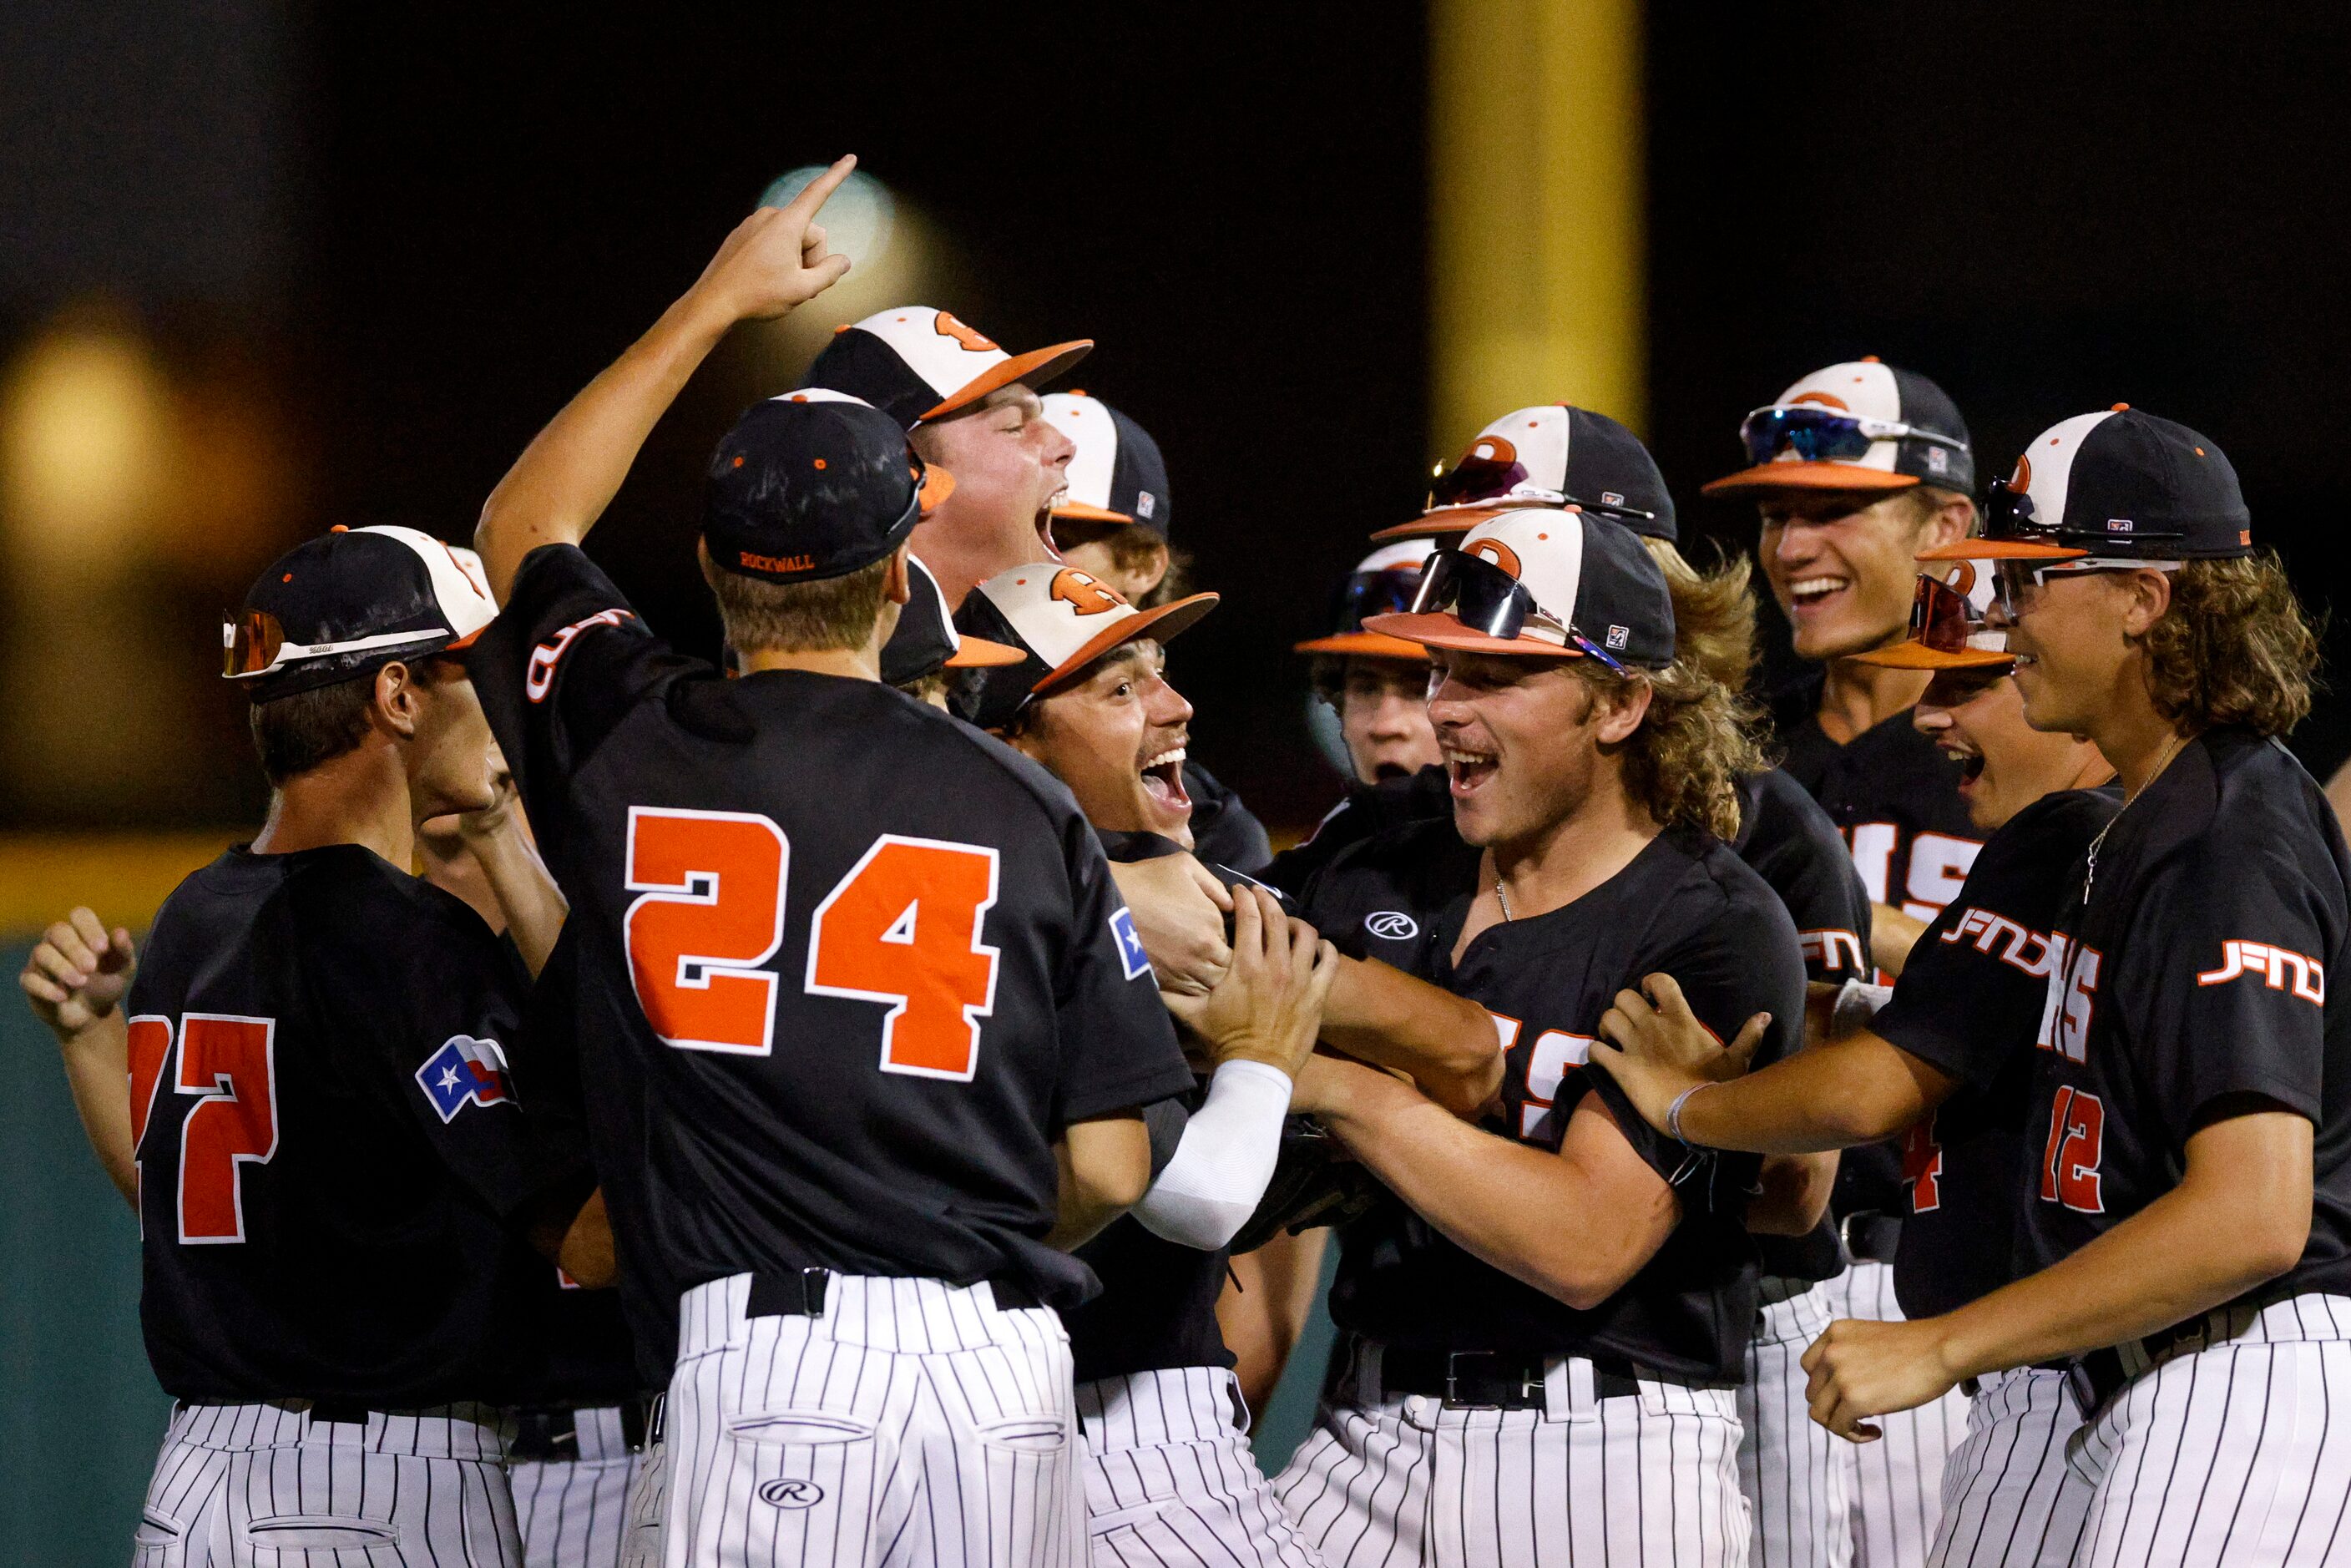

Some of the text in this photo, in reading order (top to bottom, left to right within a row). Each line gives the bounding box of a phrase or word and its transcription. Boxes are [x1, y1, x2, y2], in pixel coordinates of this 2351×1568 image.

[740, 551, 816, 573] ROCKWALL
[624, 806, 1000, 1083] 24
[2041, 1085, 2106, 1214] 12
